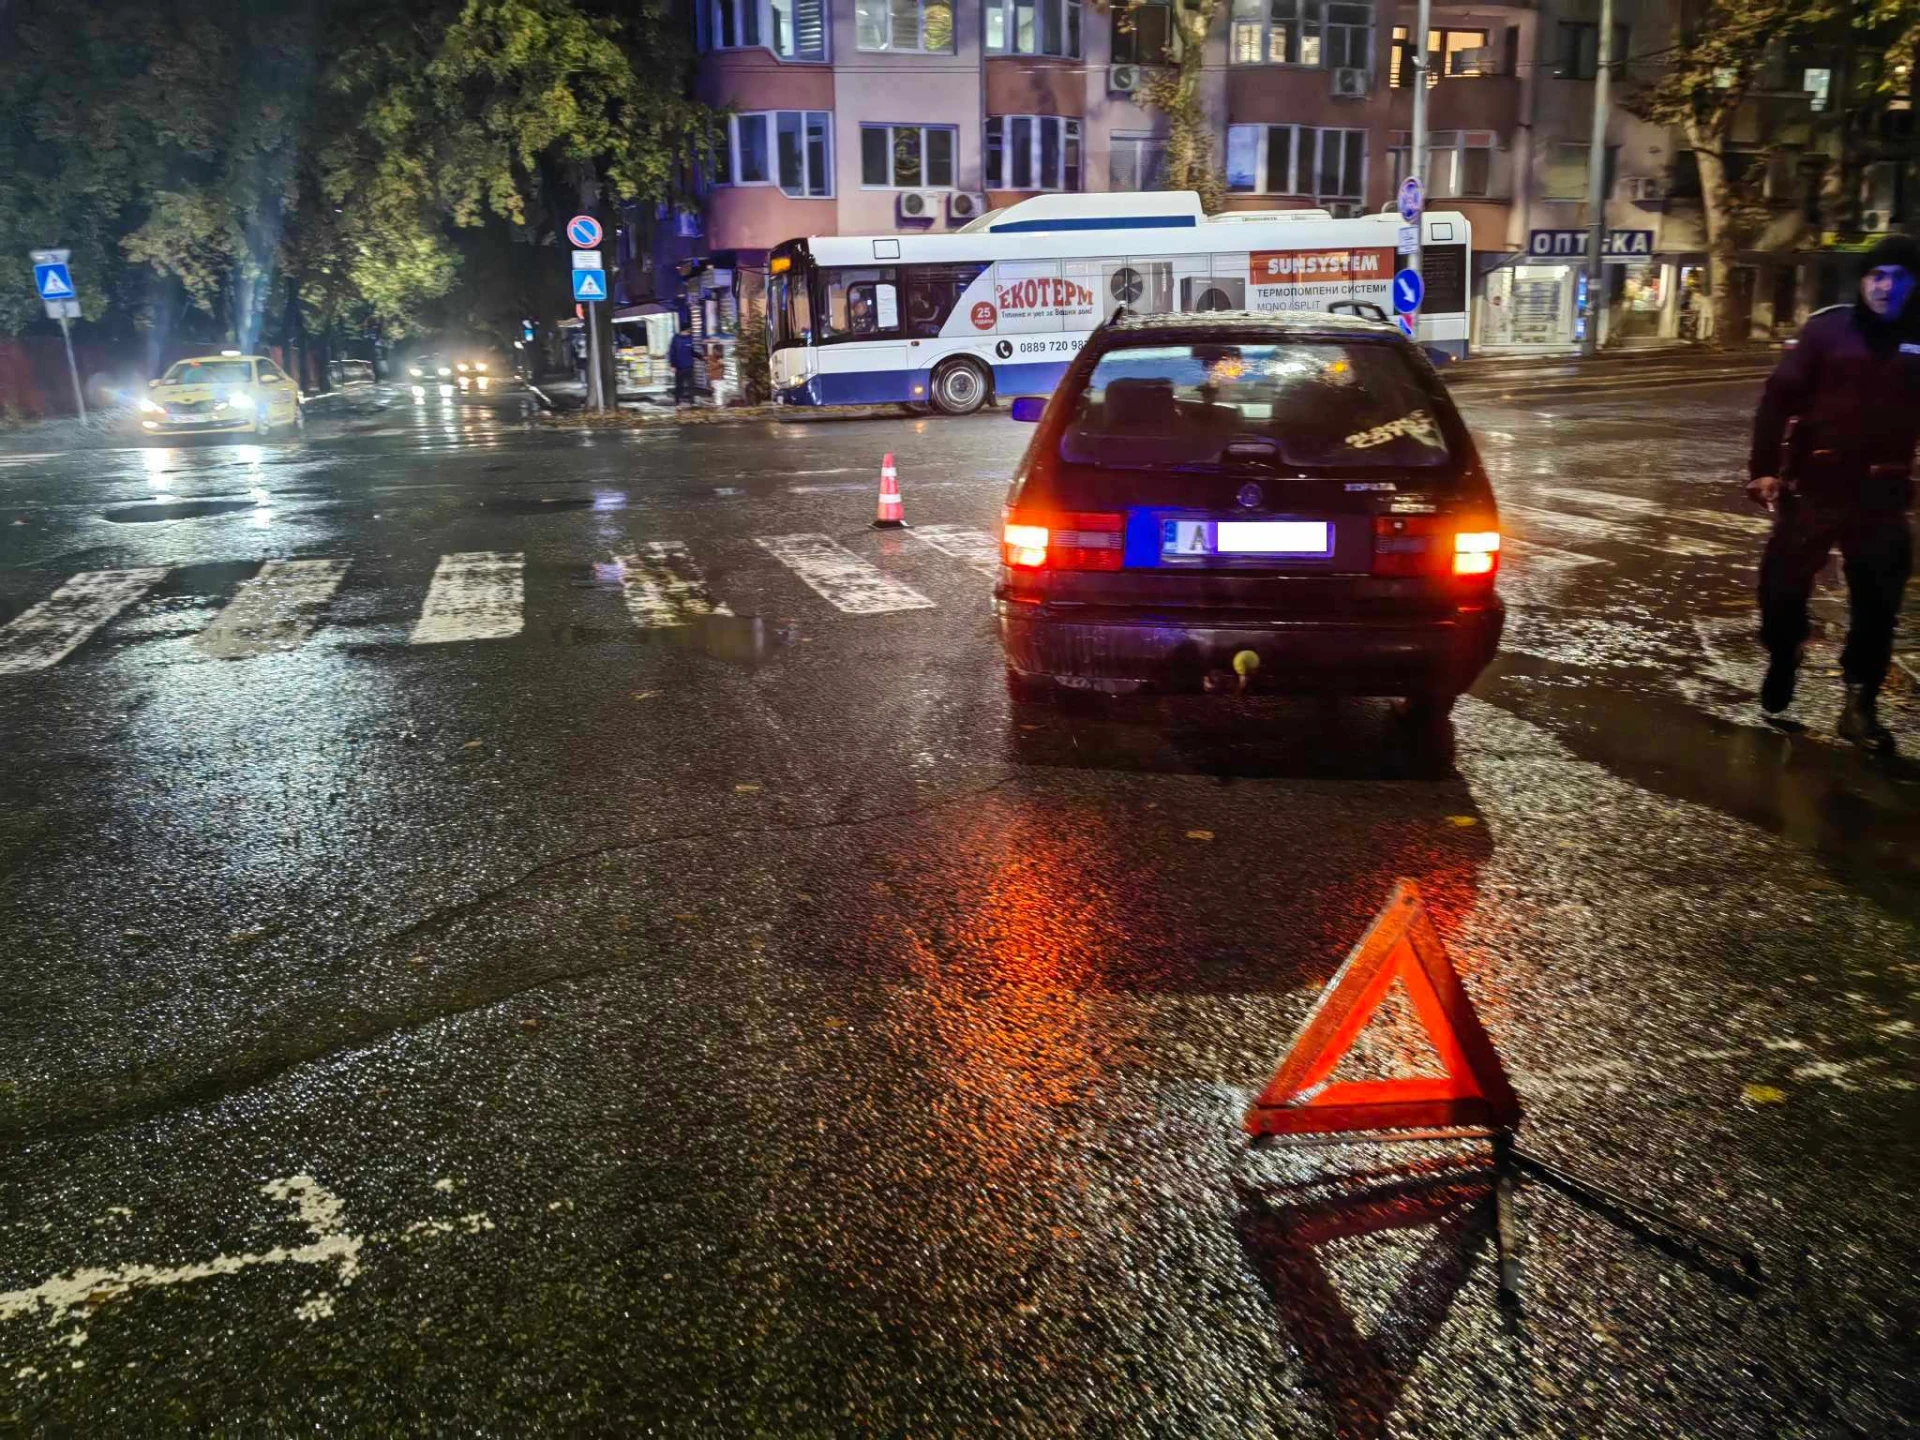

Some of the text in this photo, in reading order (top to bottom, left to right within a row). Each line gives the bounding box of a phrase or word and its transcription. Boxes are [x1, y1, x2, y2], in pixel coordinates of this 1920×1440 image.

[1268, 254, 1378, 275] SUNSYSTEM
[999, 279, 1094, 309] ЕКОТЕРМ
[1257, 284, 1387, 298] ТЕРМОПОМПЕНИ СИСТЕМИ
[977, 307, 991, 318] 25
[1257, 302, 1287, 311] MONO
[1294, 301, 1320, 310] SPLIT
[1020, 342, 1046, 353] 0889
[1049, 341, 1068, 351] 720
[1190, 525, 1208, 551] A
